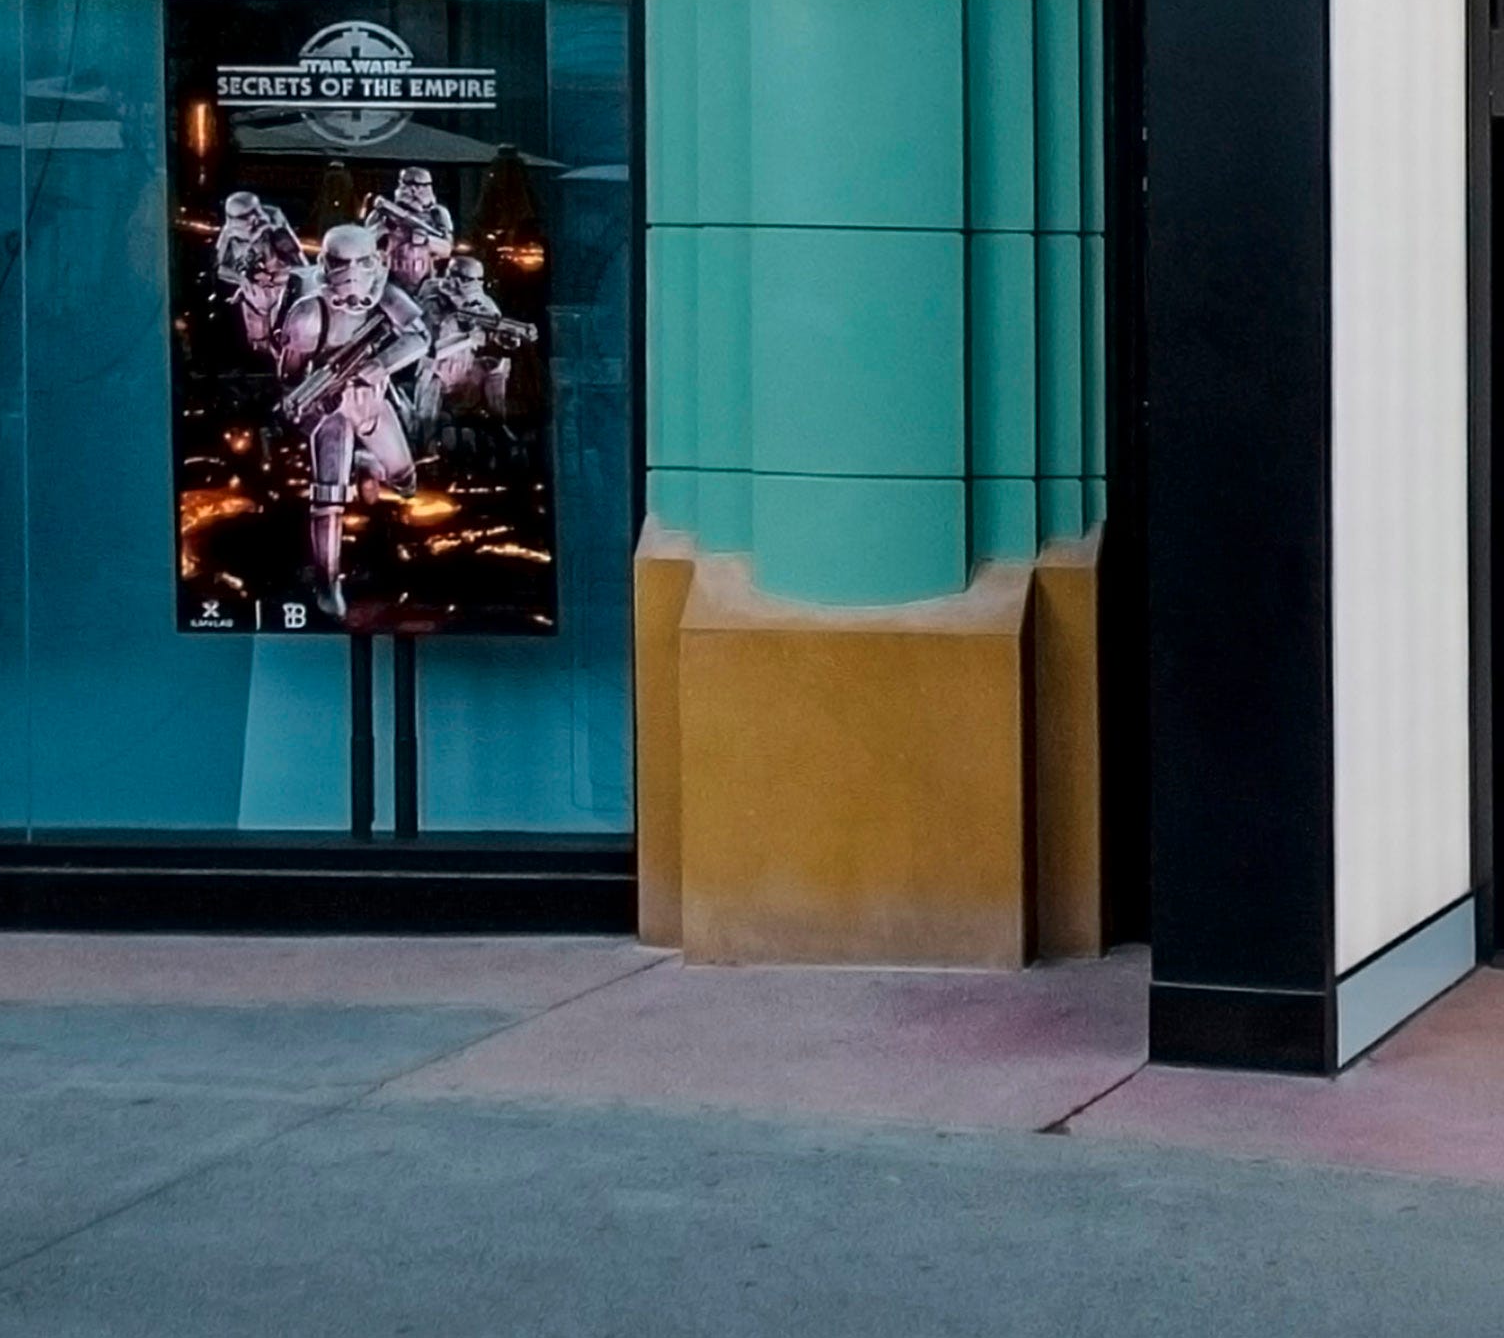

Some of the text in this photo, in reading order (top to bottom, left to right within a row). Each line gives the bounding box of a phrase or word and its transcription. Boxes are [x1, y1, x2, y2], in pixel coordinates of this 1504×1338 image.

[299, 59, 413, 75] STAR WARS
[217, 76, 496, 99] SECRETS OF THE EMPIRE
